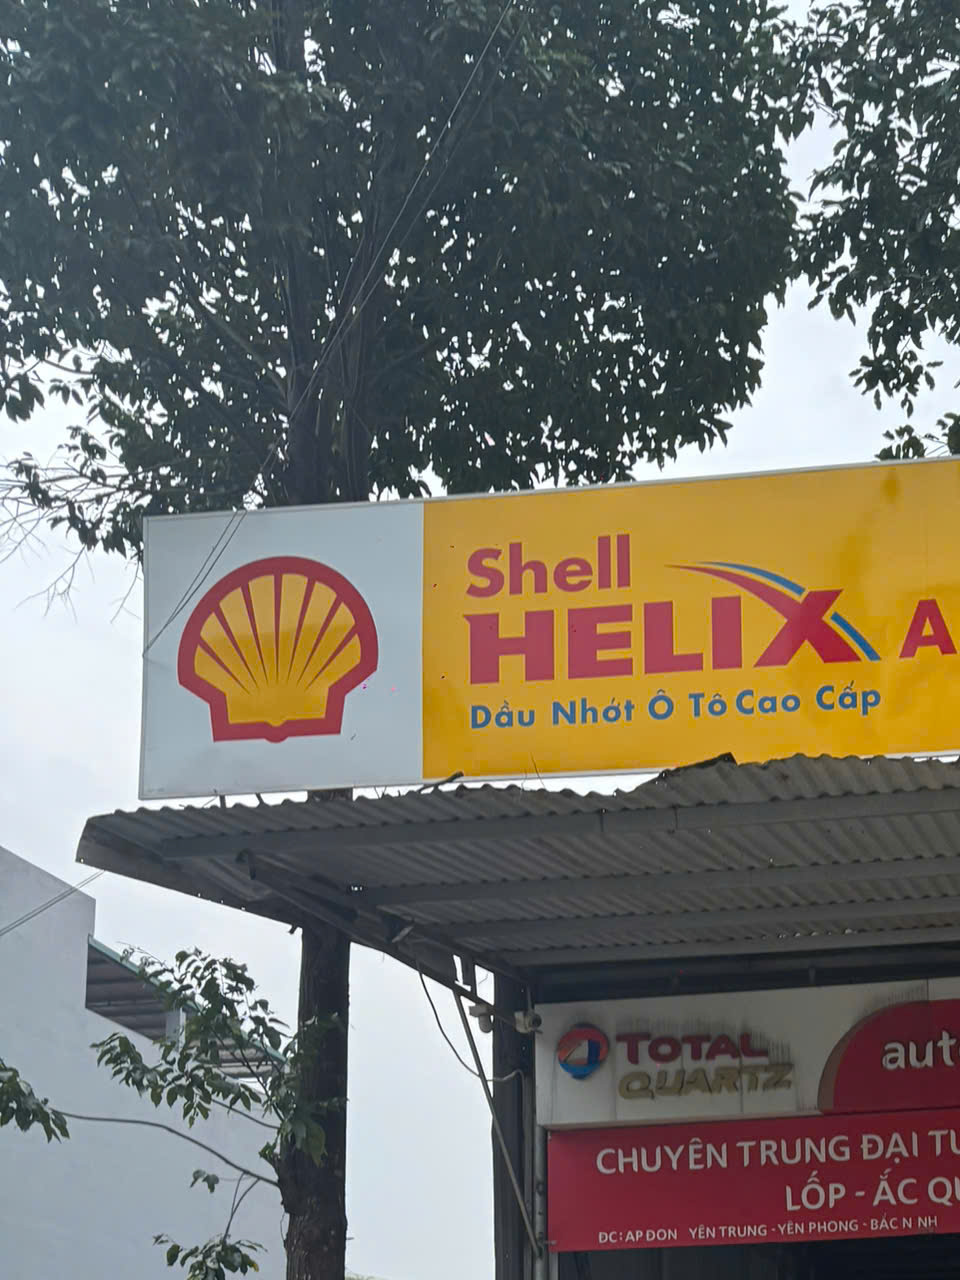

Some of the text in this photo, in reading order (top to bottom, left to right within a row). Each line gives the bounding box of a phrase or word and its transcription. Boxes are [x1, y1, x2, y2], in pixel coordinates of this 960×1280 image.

[465, 533, 631, 599] Shell
[463, 563, 866, 685] HELIX
[470, 680, 881, 729] Dầu Nhớt Ô Tô Cao Cấp
[615, 1032, 769, 1065] TOTAL
[618, 1062, 795, 1100] QUARTZ
[596, 1137, 728, 1175] CHUYÊN
[735, 1135, 851, 1168] TRUNG
[860, 1130, 919, 1164] ĐẠI
[785, 1169, 846, 1212] LỐP
[872, 1167, 918, 1207] ẮC
[688, 1224, 716, 1240] YÊN
[718, 1224, 768, 1239] TRUNG
[777, 1219, 805, 1235] YÊN
[808, 1219, 859, 1233] PHONG
